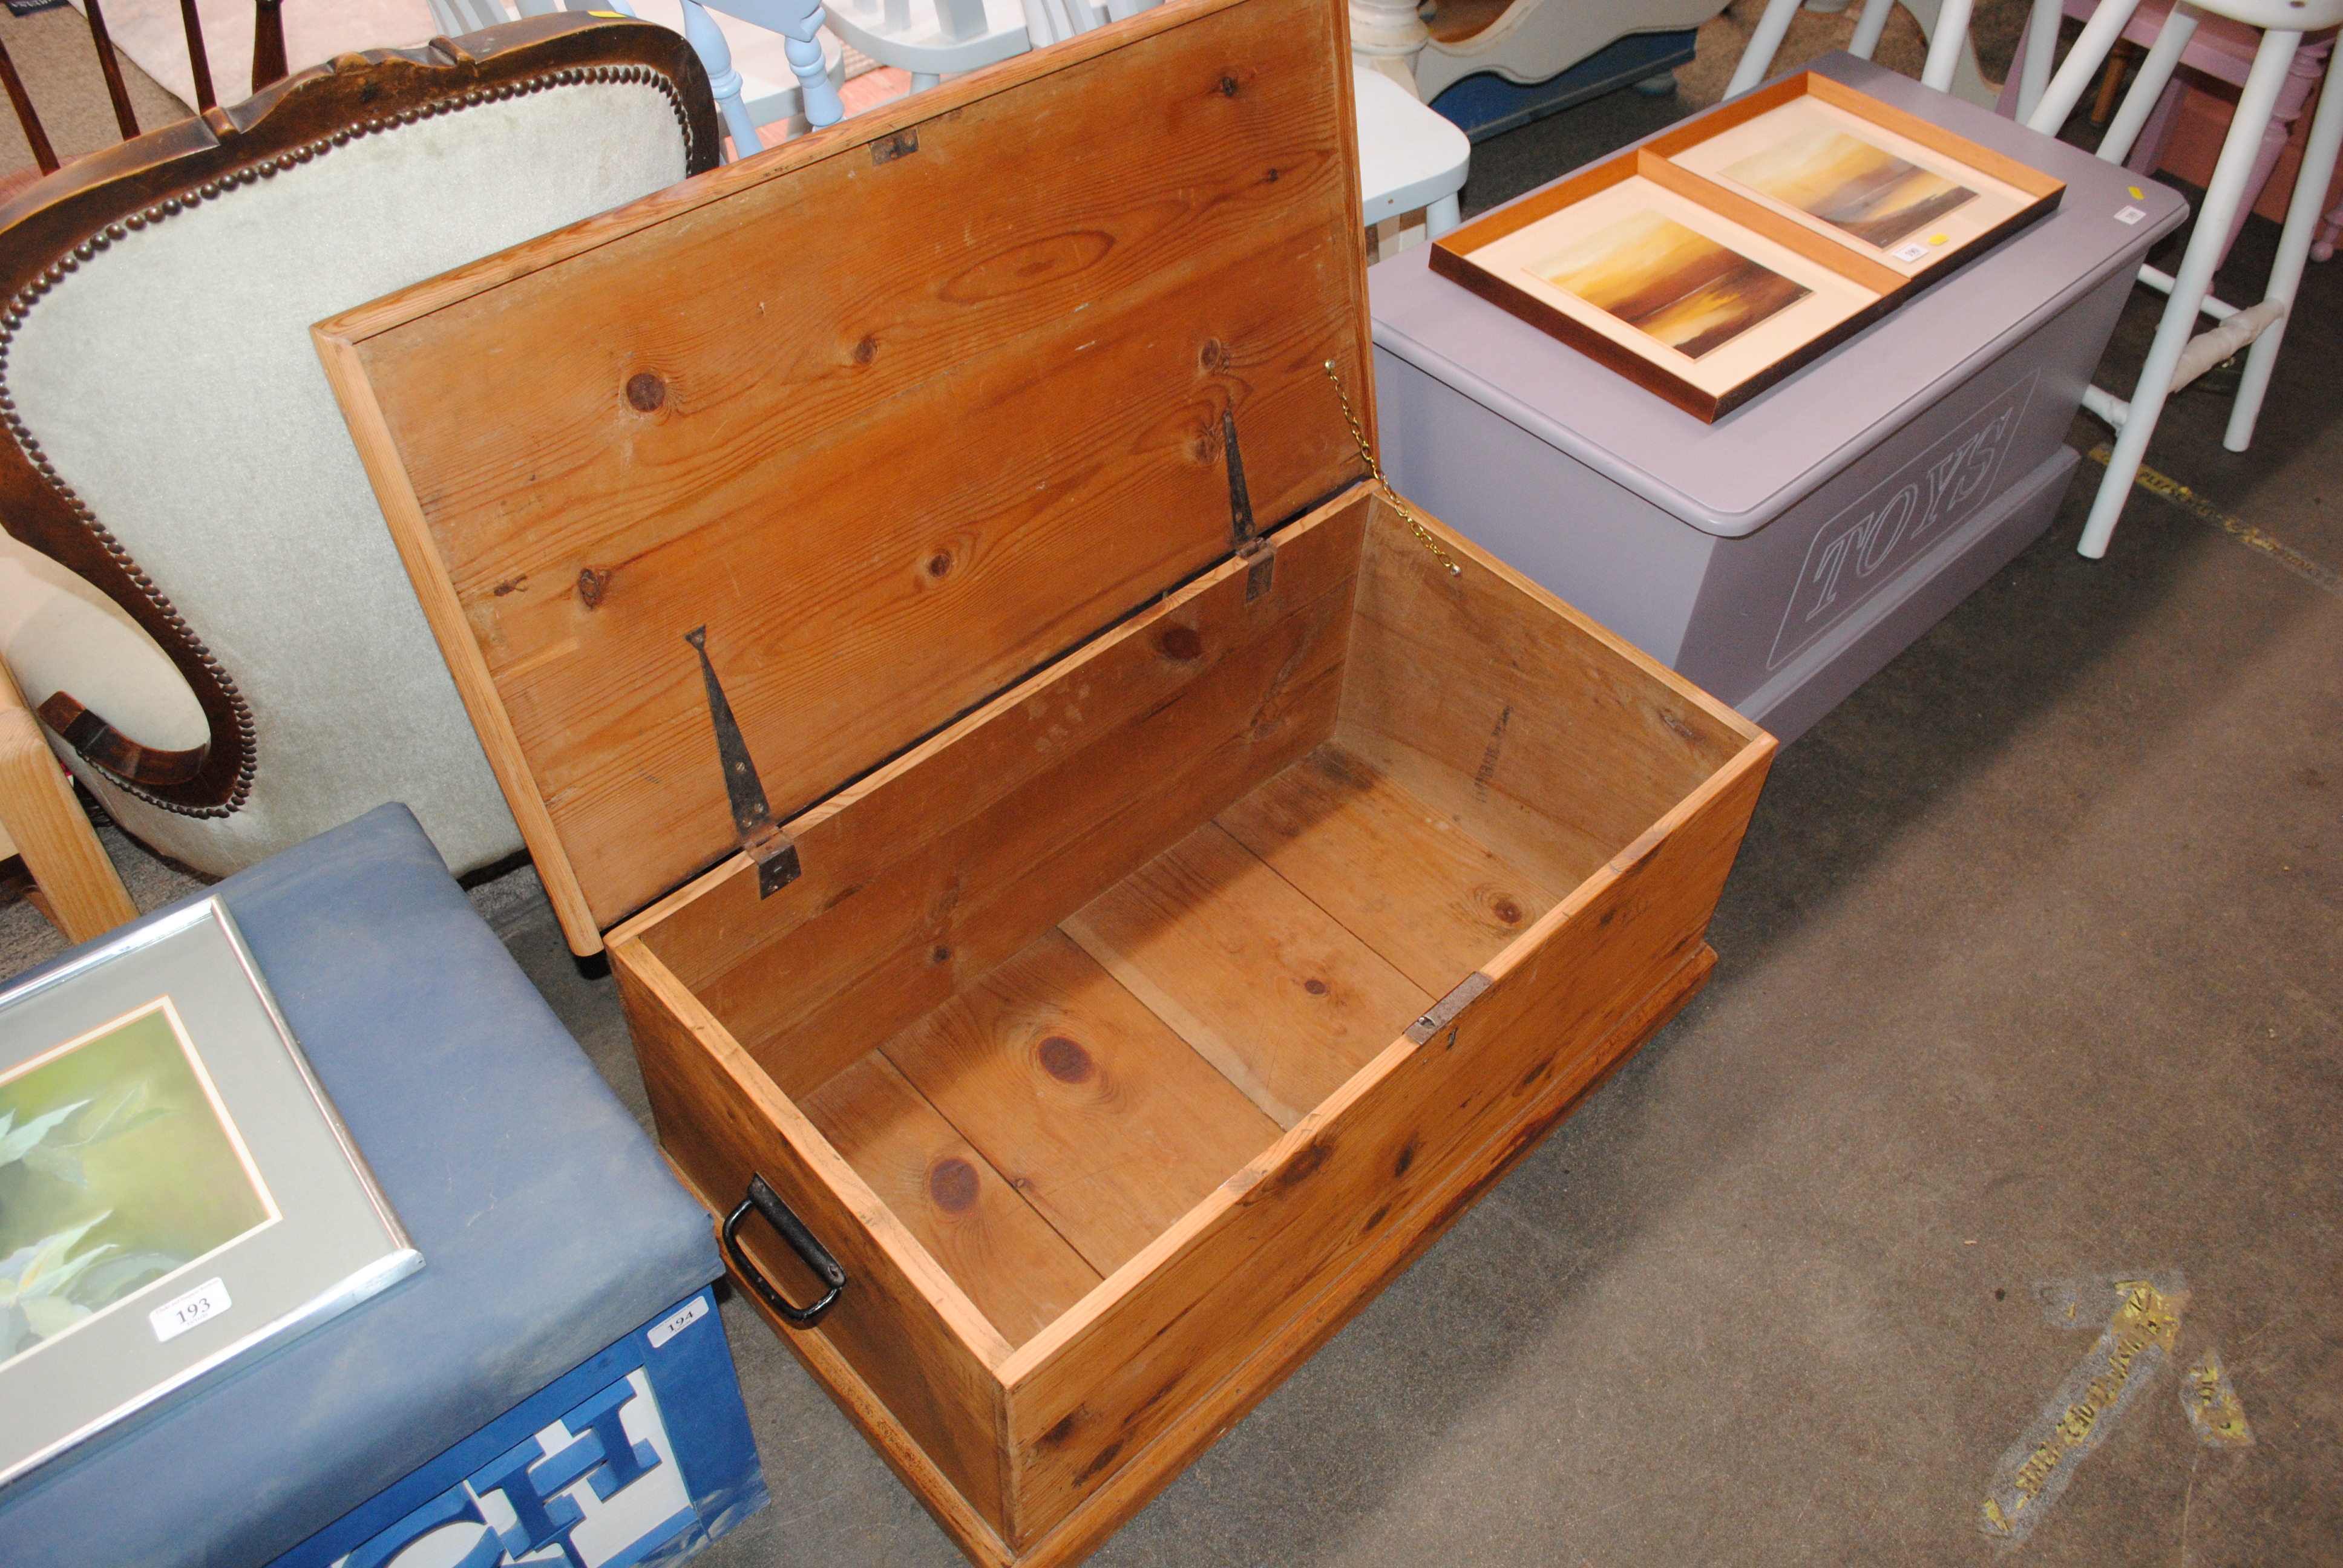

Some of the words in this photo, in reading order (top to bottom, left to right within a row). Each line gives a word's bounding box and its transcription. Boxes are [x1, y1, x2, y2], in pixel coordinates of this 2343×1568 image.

[1806, 407, 2013, 622] TOYS
[176, 1298, 211, 1324] 193
[667, 1311, 694, 1333] 194
